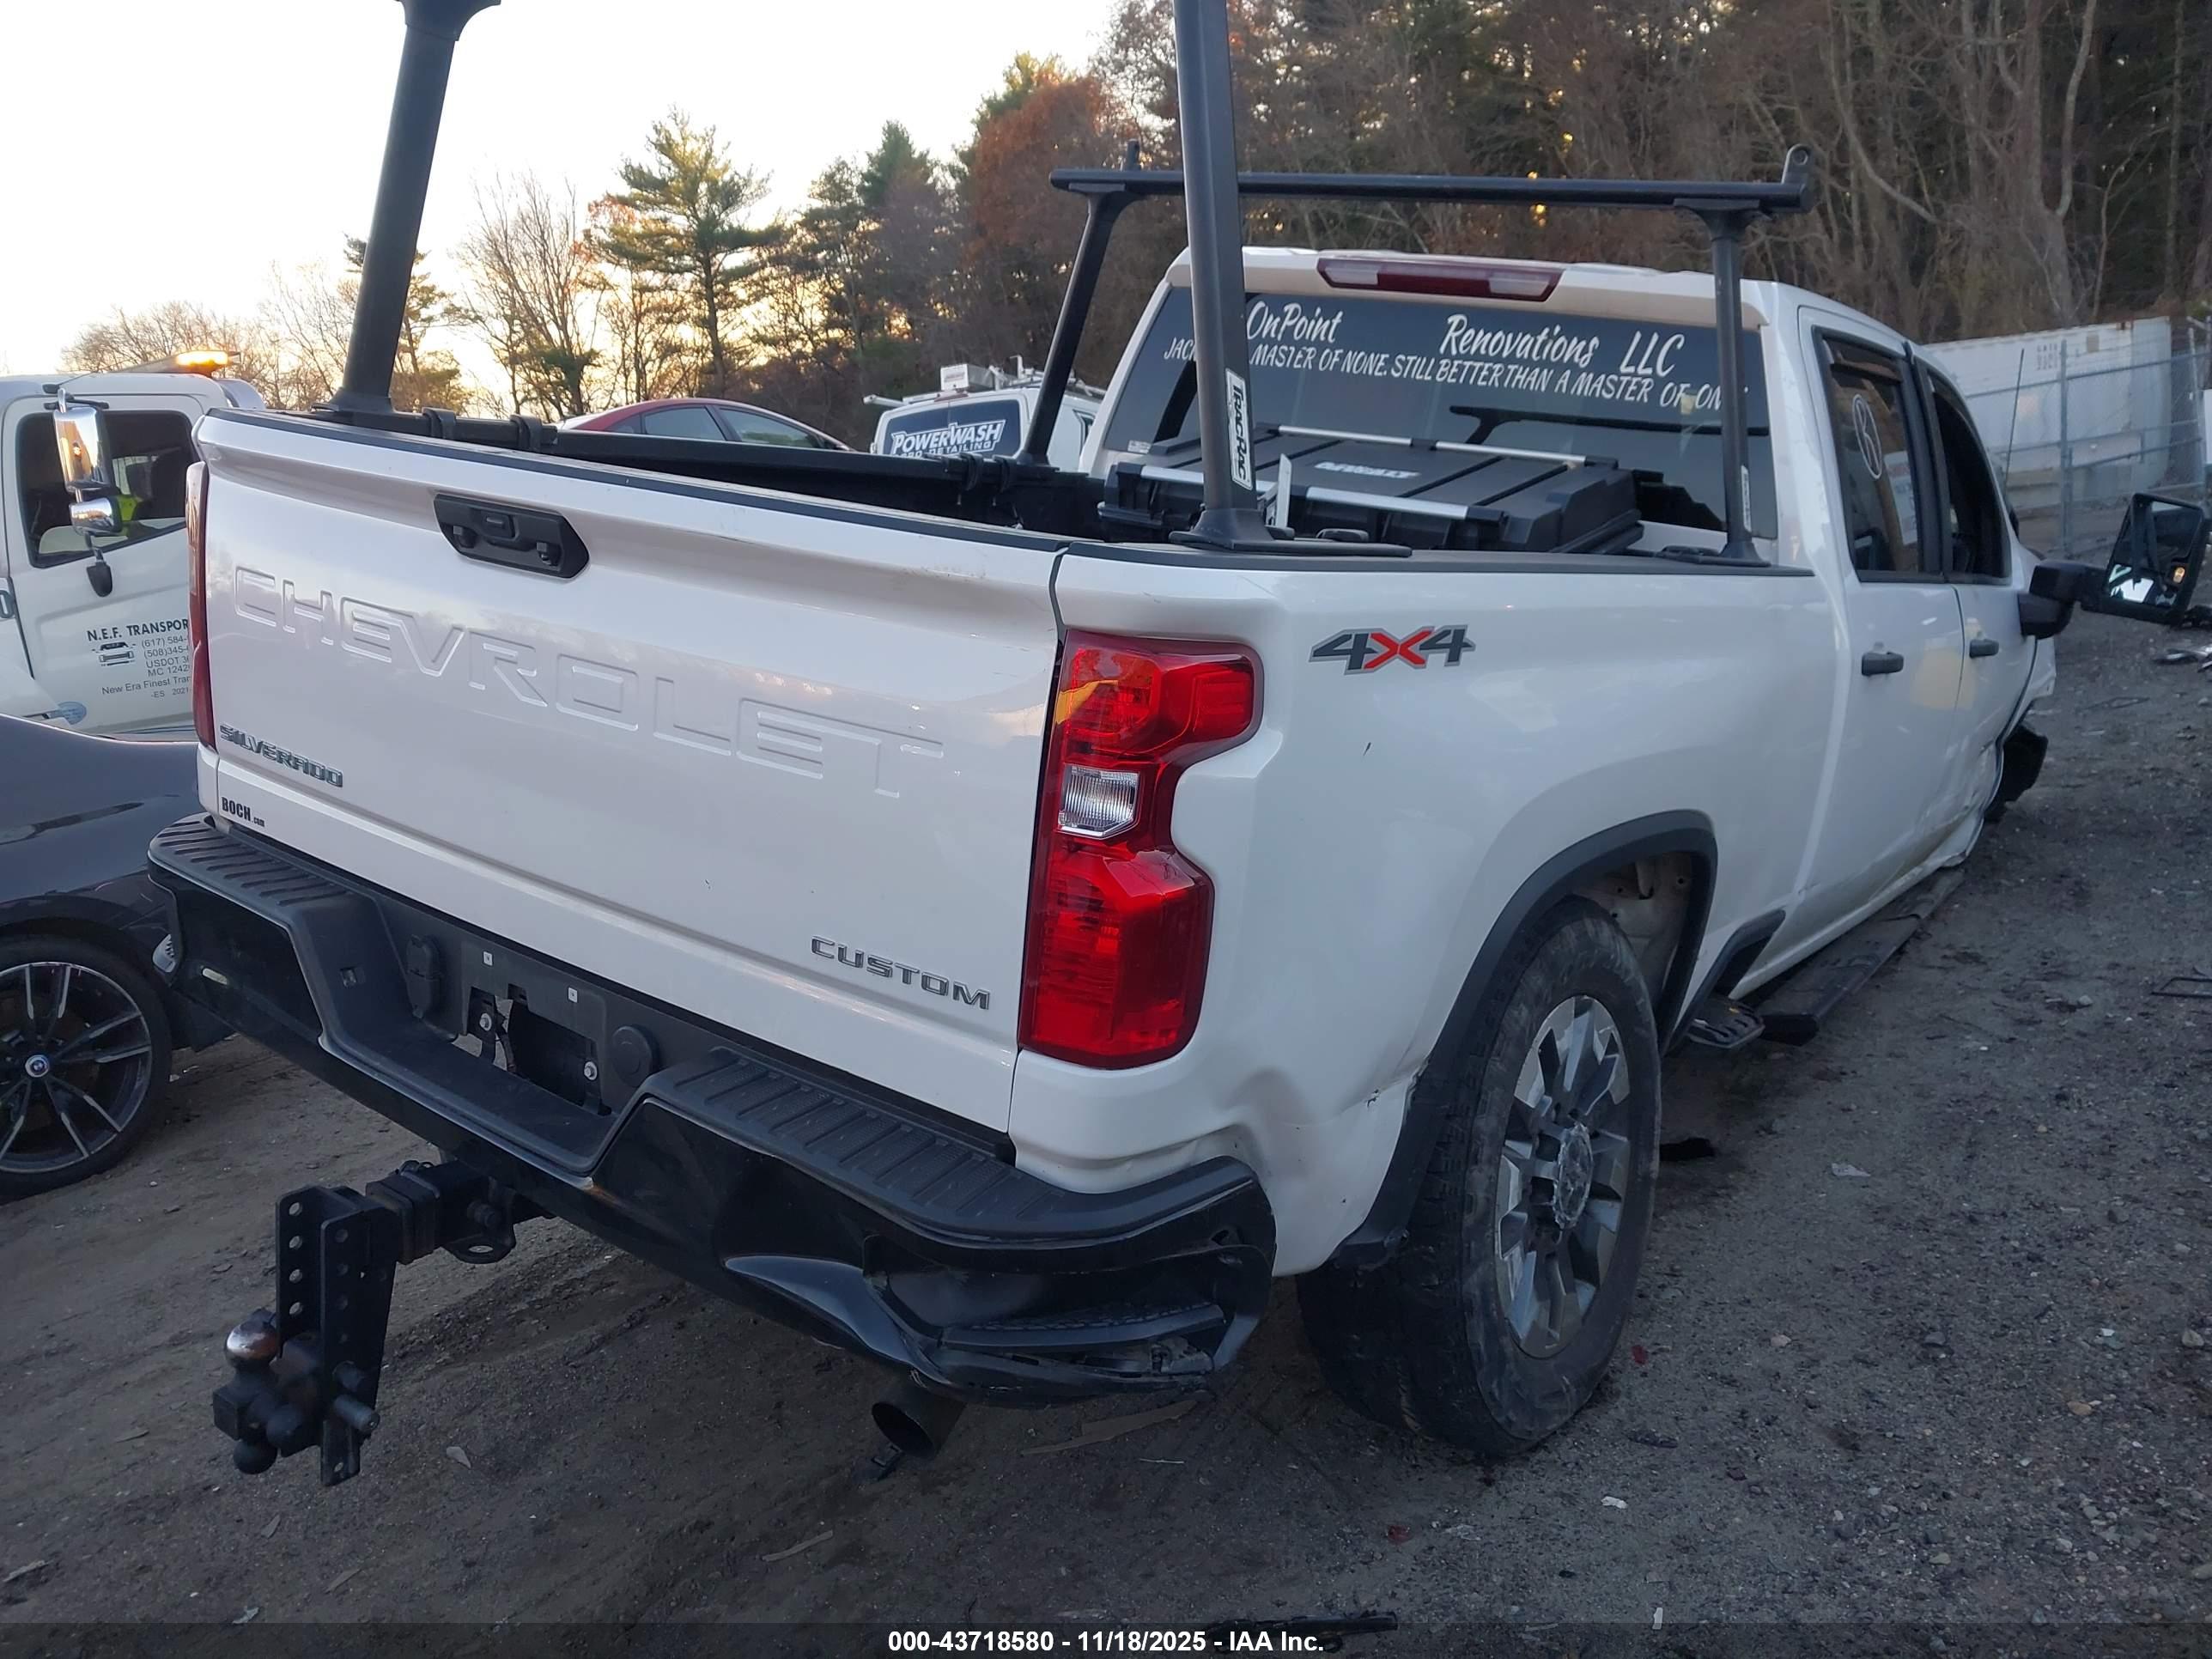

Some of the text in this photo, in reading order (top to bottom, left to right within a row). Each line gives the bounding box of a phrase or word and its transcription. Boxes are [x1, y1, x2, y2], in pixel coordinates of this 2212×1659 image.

[1247, 301, 1685, 378] OnPoint Renovations LLC
[1249, 343, 1316, 371] MASTER
[1319, 348, 1344, 372] OF
[1391, 354, 1432, 381] STILL
[1435, 358, 1504, 388] BETTER
[1503, 364, 1554, 392] THAN
[1553, 369, 1571, 394] A
[1570, 372, 1655, 404] MASTER
[1660, 381, 1691, 408] OF
[1695, 383, 1724, 411] ON
[87, 627, 122, 641] N.E.F.
[142, 638, 166, 649] (617)
[146, 656, 179, 668] USDOT
[148, 663, 189, 677] MC 1242
[234, 566, 945, 799] CHEVROLET
[102, 686, 122, 695] New
[125, 683, 141, 691] Era
[143, 678, 170, 689] Finest
[219, 722, 344, 788] SILVERADO
[811, 934, 991, 1011] CUSTOM
